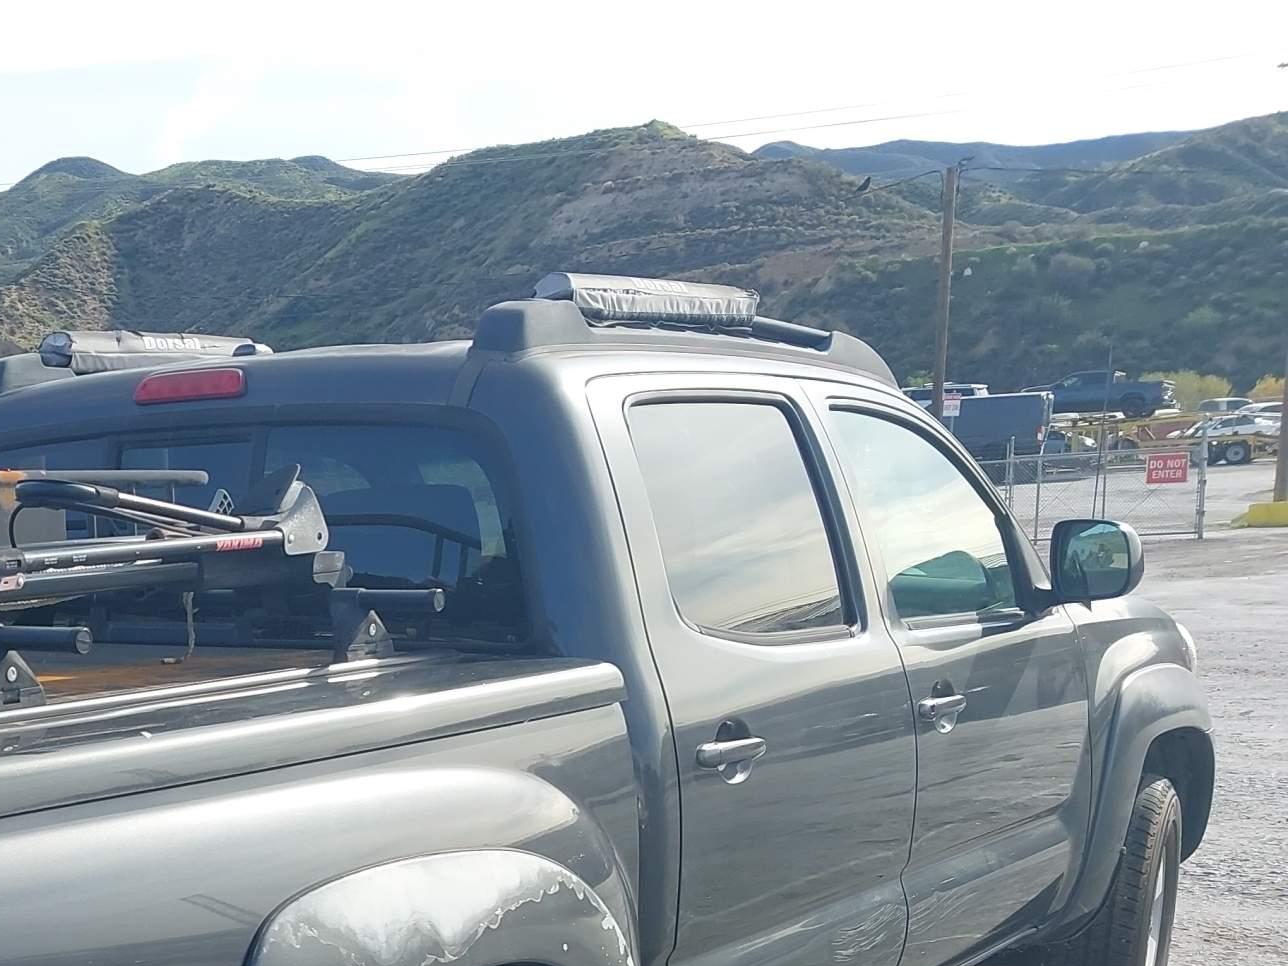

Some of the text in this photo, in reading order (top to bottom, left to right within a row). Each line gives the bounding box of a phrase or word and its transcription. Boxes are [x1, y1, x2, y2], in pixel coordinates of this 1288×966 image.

[143, 336, 200, 349] Dorsal
[1150, 459, 1186, 468] DO NOT
[1152, 470, 1182, 479] ENTER
[216, 538, 264, 552] YAKIMA
